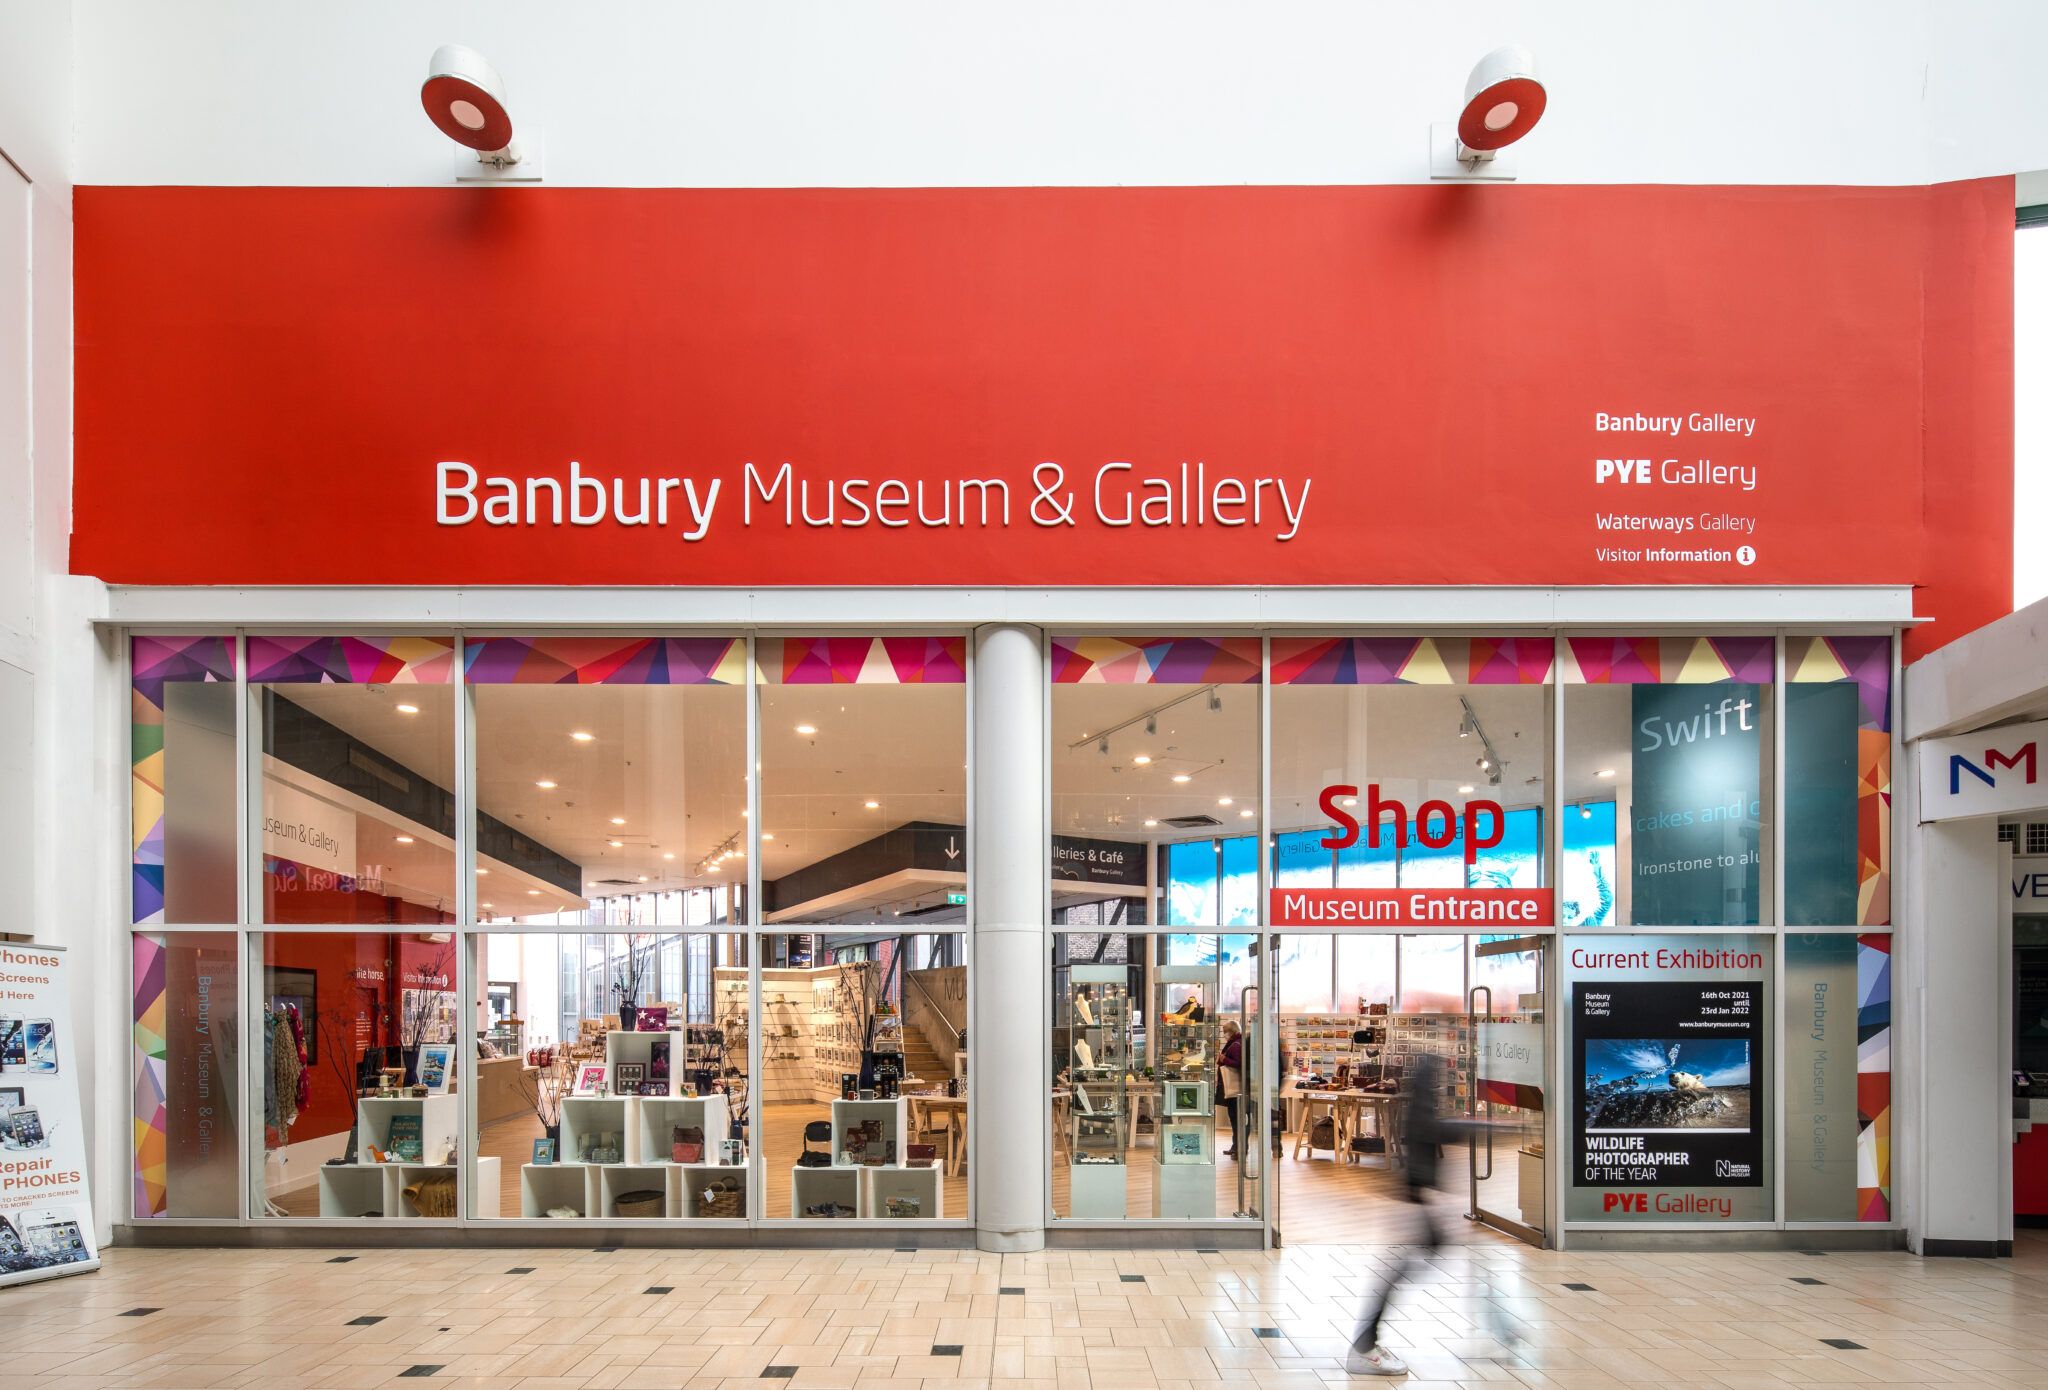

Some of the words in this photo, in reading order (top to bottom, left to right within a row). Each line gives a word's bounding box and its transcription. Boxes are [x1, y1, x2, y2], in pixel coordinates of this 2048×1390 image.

[1595, 412, 1683, 436] Banbury
[1688, 412, 1756, 437] Gallery
[1595, 459, 1652, 484] PYE
[1661, 459, 1757, 491] Gallery
[435, 460, 722, 542] Banbury
[743, 462, 1010, 527] Museum
[1029, 462, 1076, 527] &
[1094, 461, 1312, 542] Gallery
[1595, 512, 1695, 534] Waterways
[1699, 512, 1756, 535] Gallery
[1596, 548, 1641, 562] Visitor
[1645, 547, 1732, 562] Information
[1639, 697, 1753, 753] Swift
[1318, 783, 1505, 866] Shop
[1636, 809, 1694, 833] cakes
[1700, 798, 1742, 824] and
[298, 823, 307, 844] &
[308, 827, 339, 858] Gallery
[1088, 849, 1097, 862] &
[1099, 850, 1124, 864] Café
[1638, 857, 1713, 876] Ironstone
[1718, 853, 1735, 869] to
[1283, 894, 1400, 920] Museum
[1409, 894, 1538, 920] Entrance
[0, 949, 60, 967] hones
[1571, 948, 1650, 969] Current
[1656, 948, 1762, 969] Exhibition
[0, 972, 50, 985] Screens
[7, 990, 35, 1000] Here
[1585, 992, 1611, 1001] Banbury
[1585, 1000, 1610, 1008] Museum
[1732, 991, 1750, 999] 2021
[1733, 999, 1750, 1007] until
[195, 975, 212, 1035] Banbury
[1591, 1008, 1610, 1016] Gallery
[1718, 1007, 1730, 1015] Jan
[1731, 1007, 1749, 1015] 2022
[1811, 982, 1828, 1042] Banbury
[1679, 1020, 1750, 1029] www.banburymuseum.org
[1495, 1042, 1502, 1058] &
[1503, 1043, 1531, 1064] Gallery
[198, 1042, 212, 1099] Museum
[1813, 1049, 1828, 1107] Museum
[198, 1105, 213, 1117] &
[1813, 1114, 1828, 1126] &
[1585, 1136, 1644, 1150] WILDLIFE
[1811, 1127, 1828, 1175] Gallery
[1585, 1152, 1690, 1166] PHOTOGRAPHER
[3, 1171, 81, 1190] PHONES
[1585, 1167, 1601, 1181] OF
[1602, 1167, 1625, 1181] THE
[1627, 1167, 1657, 1181] YEAR
[11, 1200, 33, 1209] MORE!
[13, 1192, 47, 1202] CRACKED
[47, 1189, 79, 1198] SCREENS
[1603, 1193, 1648, 1213] PYE
[1655, 1193, 1732, 1217] Gallery
